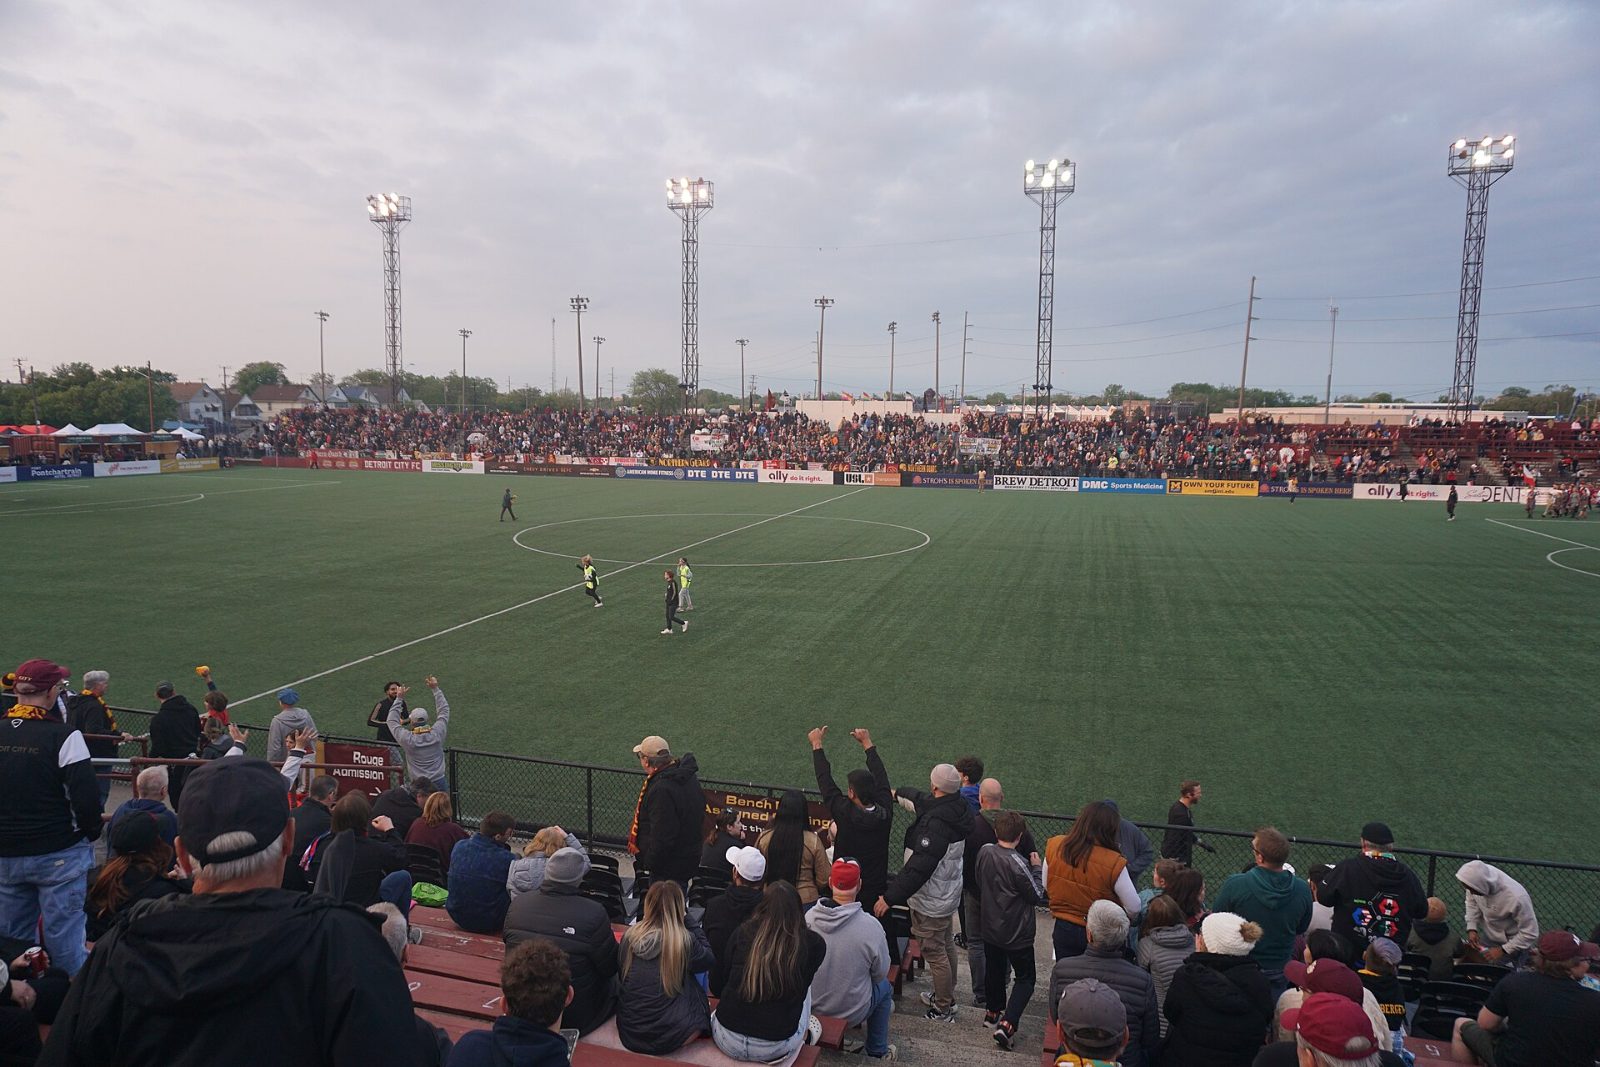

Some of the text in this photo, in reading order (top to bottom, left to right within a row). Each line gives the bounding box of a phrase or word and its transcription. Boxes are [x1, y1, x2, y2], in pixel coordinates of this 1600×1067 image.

[364, 460, 391, 469] DETROIT
[394, 461, 410, 469] CITY
[411, 461, 421, 470] FC
[31, 468, 82, 477] Pontchartrain
[687, 469, 707, 478] DTE
[711, 471, 731, 479] DTE
[768, 471, 788, 482] ally
[846, 474, 864, 483] USL
[994, 476, 1079, 488] BREW DETROIT
[1082, 481, 1108, 489] DMC
[1111, 482, 1132, 490] Sports
[1334, 487, 1352, 495] HERE
[1368, 485, 1394, 498] ally
[353, 751, 384, 767] Rouge
[726, 794, 772, 810] Bench
